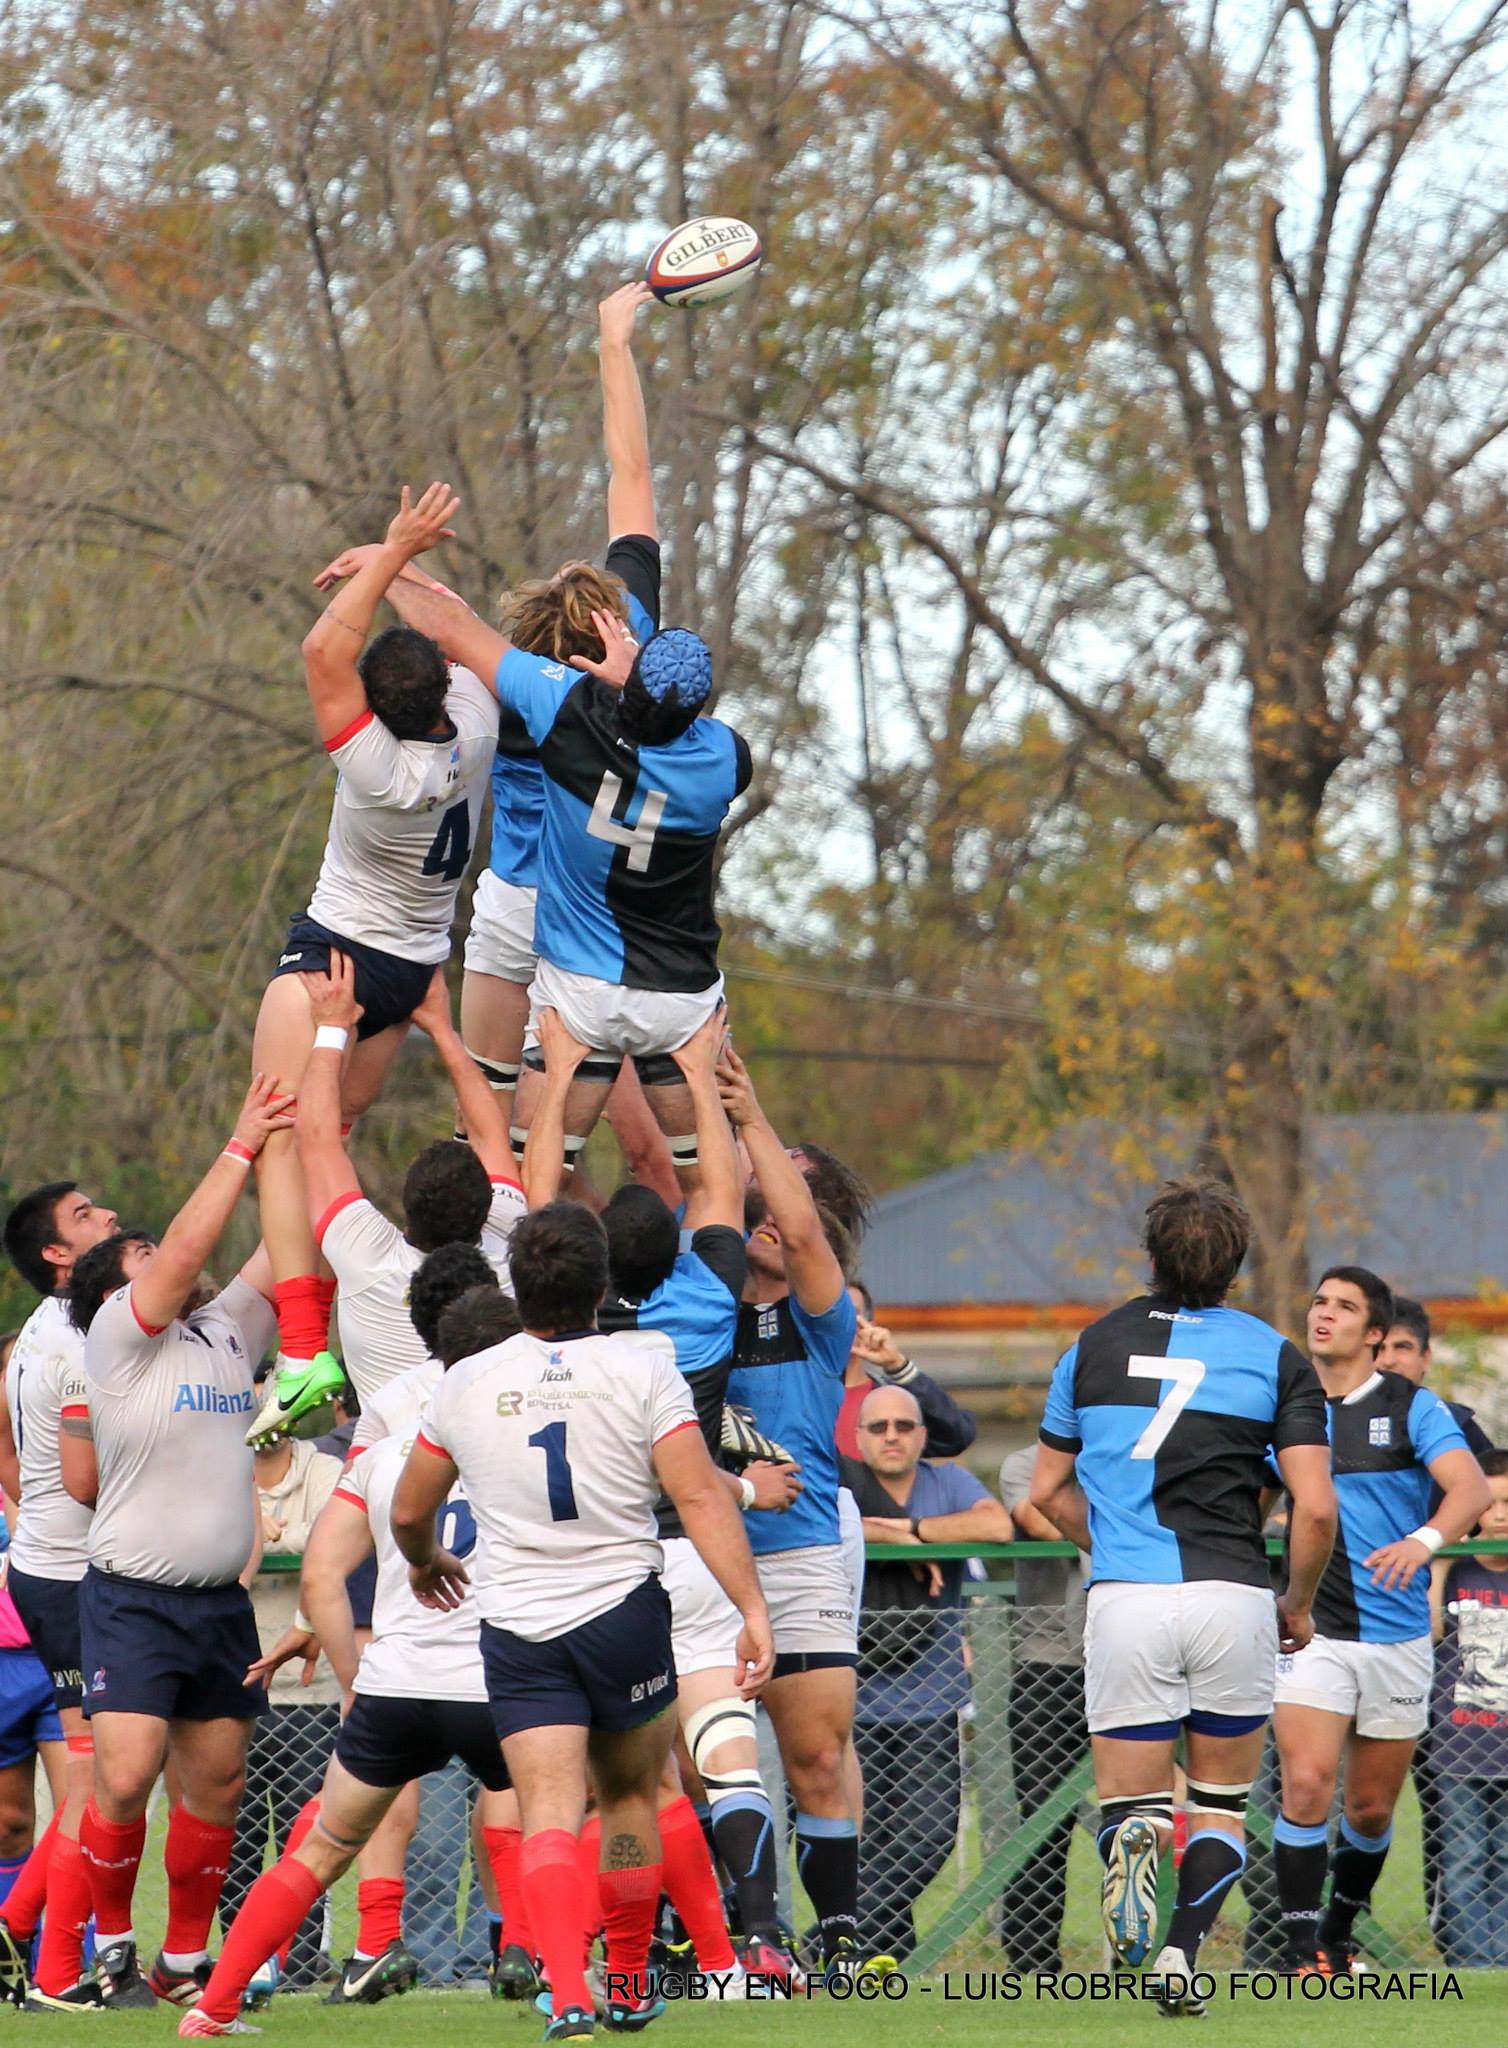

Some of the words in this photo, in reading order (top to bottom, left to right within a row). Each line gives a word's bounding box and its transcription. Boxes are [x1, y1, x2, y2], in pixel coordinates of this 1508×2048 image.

[665, 224, 751, 268] GILBERT
[421, 798, 471, 883] 4
[586, 769, 668, 873] 4
[174, 1384, 253, 1414] Allianz
[1127, 1355, 1206, 1460] 7
[529, 1421, 579, 1522] 1
